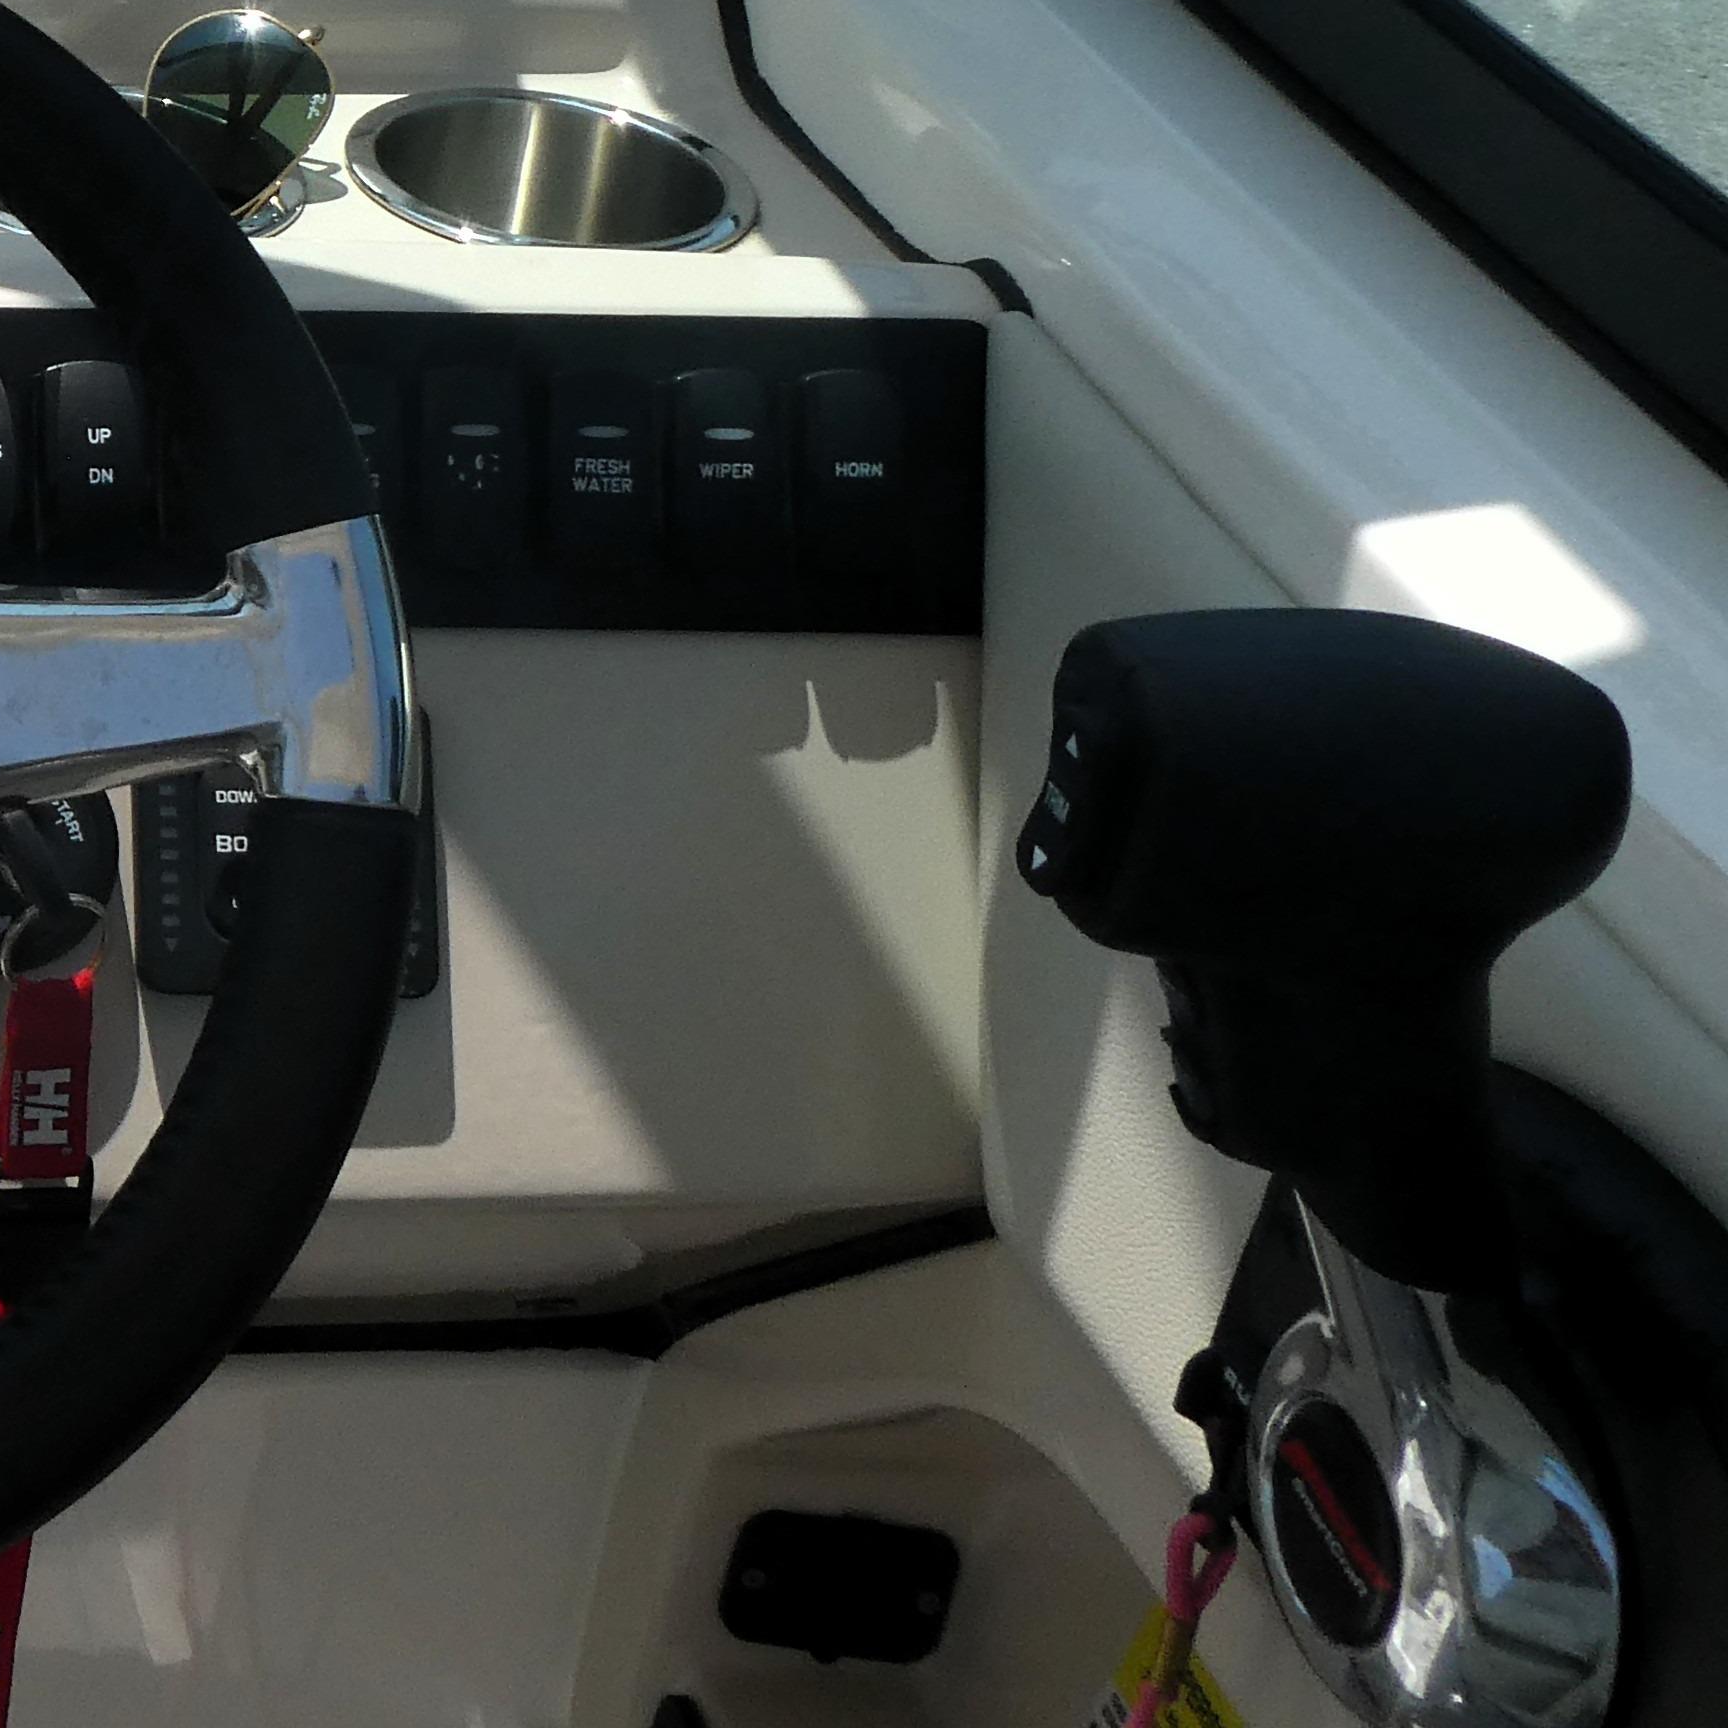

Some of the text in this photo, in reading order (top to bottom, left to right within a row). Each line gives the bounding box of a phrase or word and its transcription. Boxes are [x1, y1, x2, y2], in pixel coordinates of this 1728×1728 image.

[87, 428, 112, 444] UP
[574, 458, 631, 475] FRESH
[699, 463, 755, 479] WIPER
[834, 462, 884, 478] HORN
[88, 468, 114, 484] DN
[571, 477, 633, 493] WATER
[215, 790, 258, 804] DOW
[51, 800, 84, 842] TART
[216, 834, 248, 852] BO
